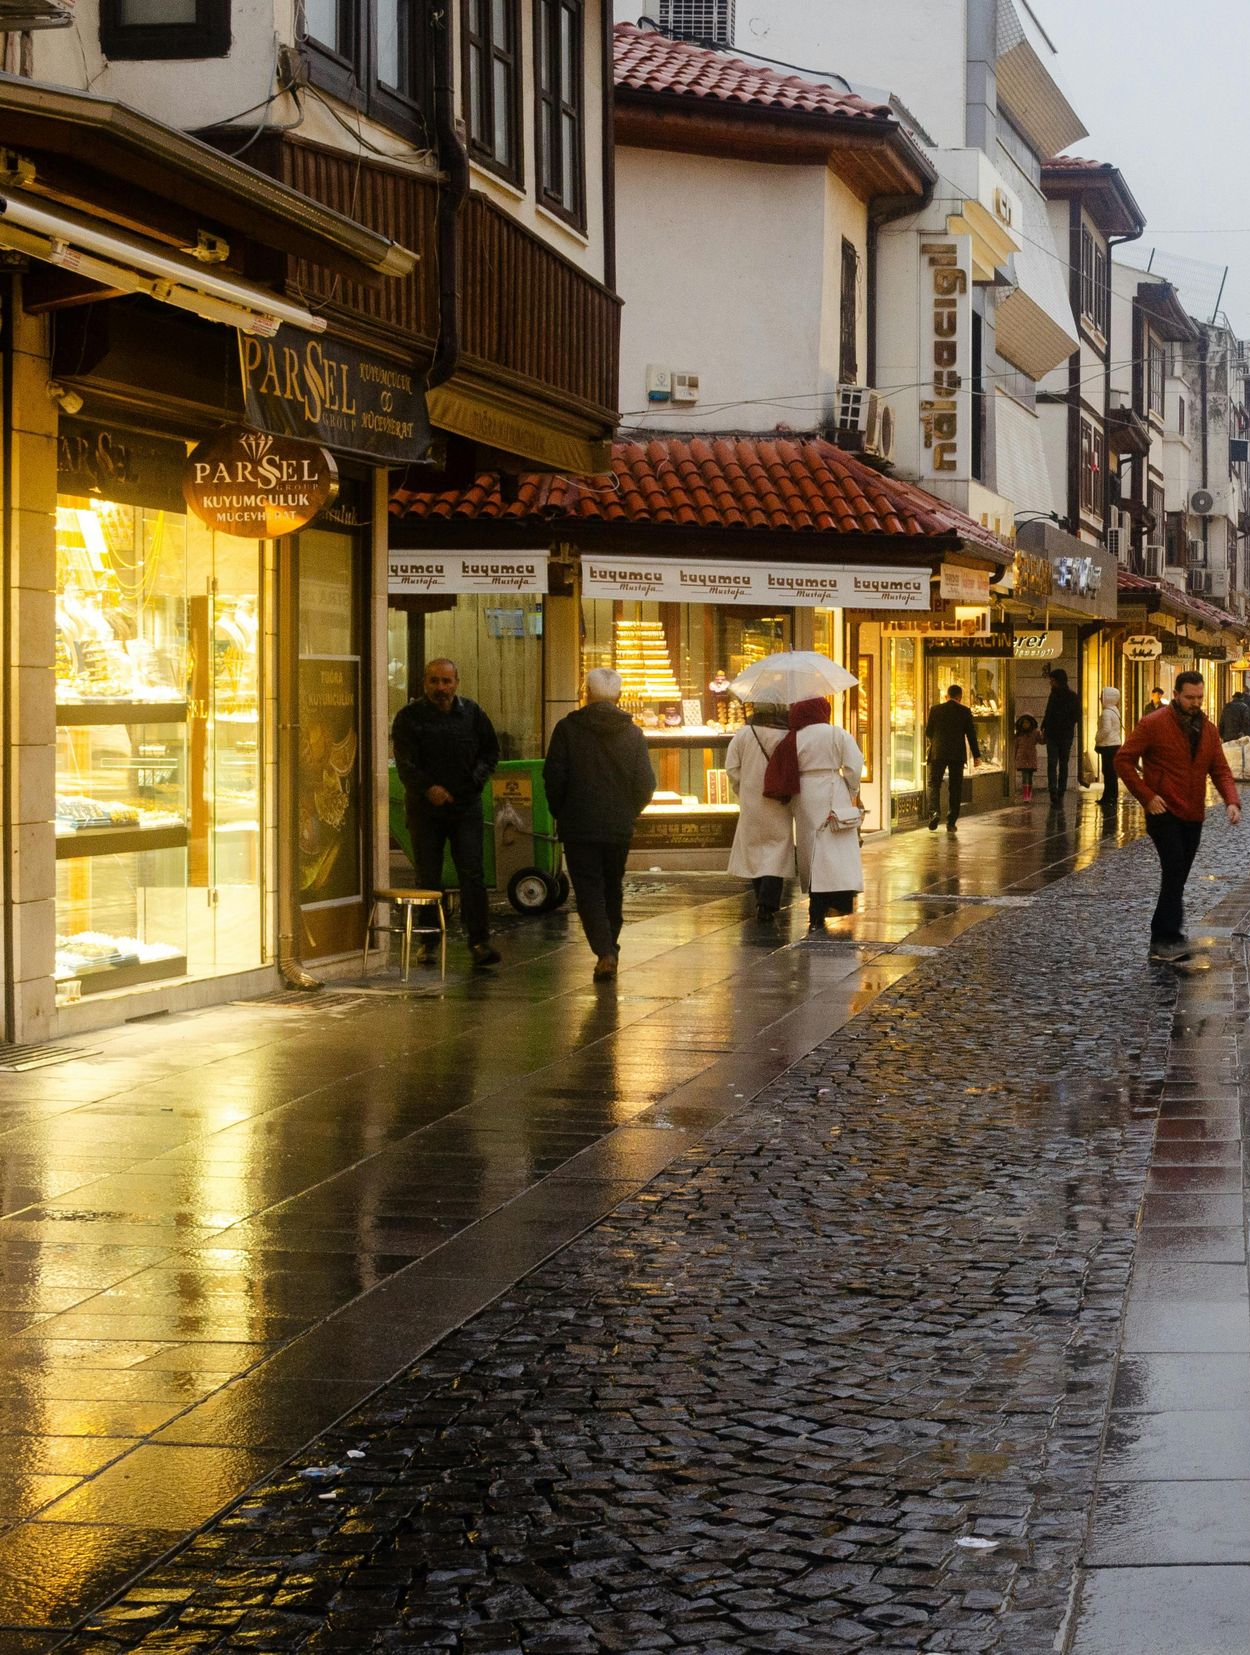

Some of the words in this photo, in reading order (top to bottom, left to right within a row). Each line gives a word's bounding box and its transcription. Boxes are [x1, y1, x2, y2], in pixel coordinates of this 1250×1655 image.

[244, 337, 356, 424] PARSEL
[360, 363, 413, 395] KUYUMCULUK
[323, 413, 357, 432] GROUP
[361, 412, 414, 439] MÜCEVHERAT
[194, 455, 319, 489] PARSEL
[276, 483, 319, 491] GROUP
[203, 493, 310, 509] KUYUMCULUK
[388, 562, 444, 577] yumcu
[461, 561, 535, 577] kuyumcu
[589, 566, 663, 582] kuyumcu
[401, 577, 438, 589] Mustafa
[491, 577, 529, 590] Mustafa
[680, 570, 751, 585] kuyumcu
[768, 573, 837, 589] kuyumcu
[854, 576, 922, 592] kuyumcu
[619, 583, 656, 596] Mustafa
[709, 587, 745, 600] Mustafa
[796, 591, 831, 603] Mustafa
[881, 592, 916, 605] Mustafa
